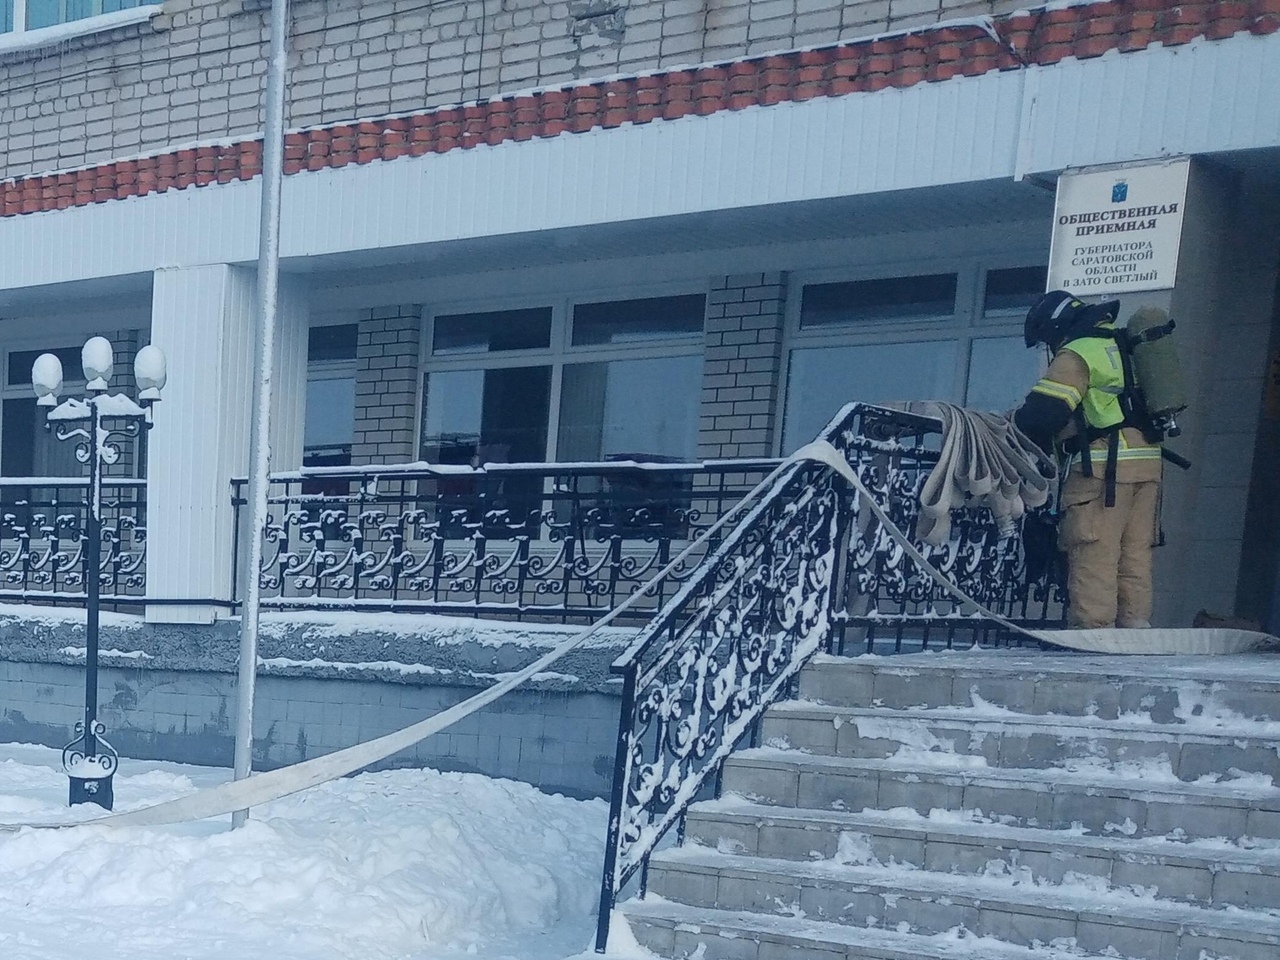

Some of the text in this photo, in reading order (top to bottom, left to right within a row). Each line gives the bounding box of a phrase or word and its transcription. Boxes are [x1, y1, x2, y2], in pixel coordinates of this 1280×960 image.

[1059, 203, 1179, 225] ОБЩЕСТВЕННАЯ
[1075, 219, 1157, 236] ПРИЕМНАЯ
[1074, 241, 1153, 256] ГУБЕРНАТОРА
[1071, 250, 1154, 266] САРАТОВСКОЙ
[1085, 263, 1137, 275] ОБЛАСТИ
[1063, 269, 1158, 287] В ЗАТО СВЕТЛЫЙ
